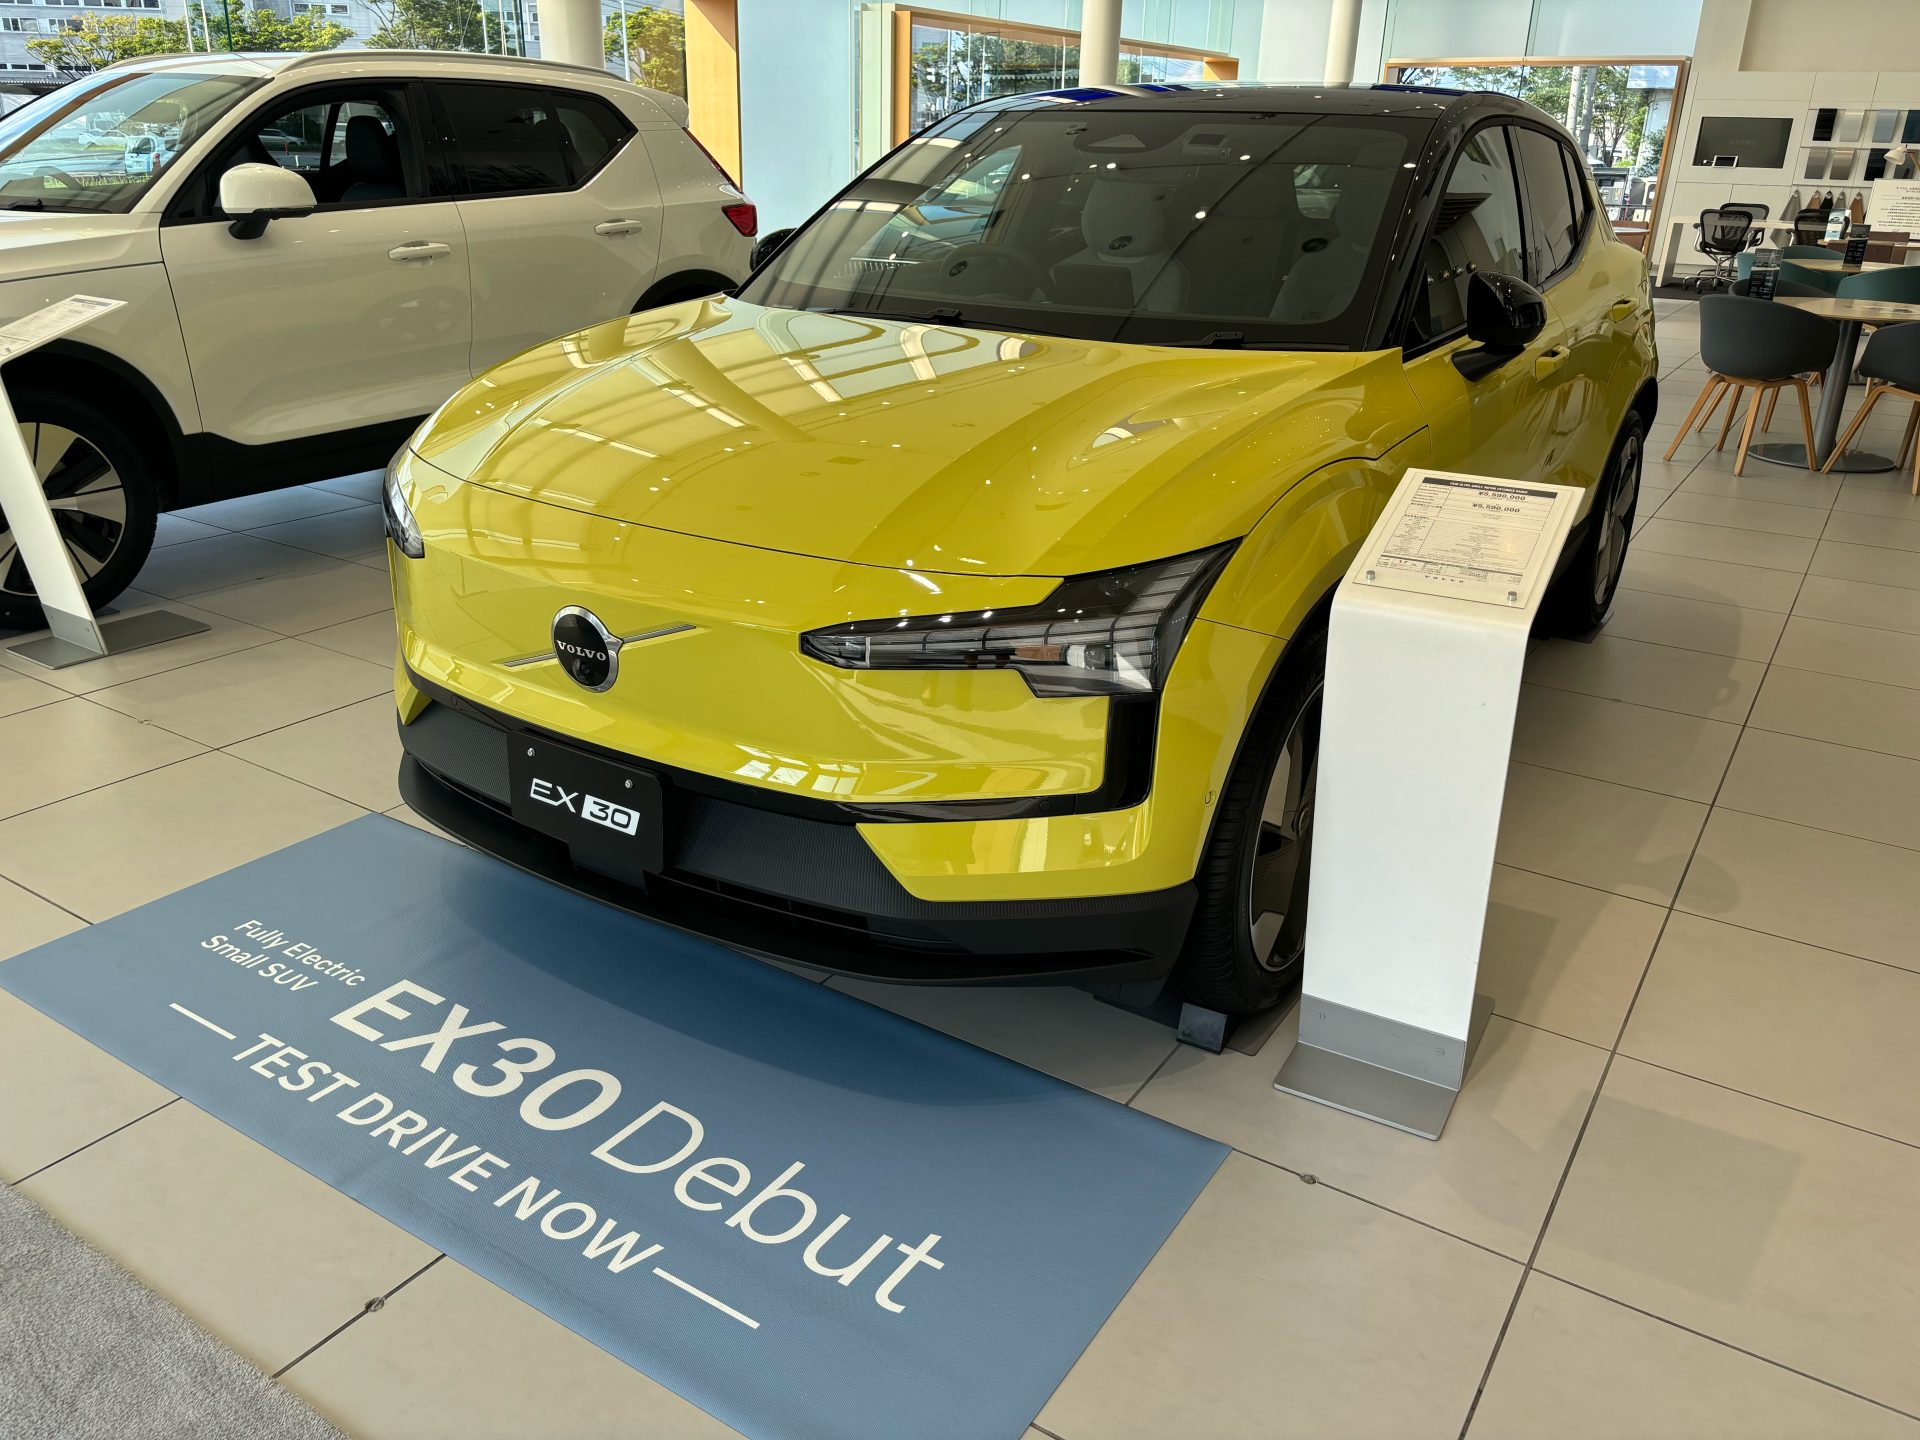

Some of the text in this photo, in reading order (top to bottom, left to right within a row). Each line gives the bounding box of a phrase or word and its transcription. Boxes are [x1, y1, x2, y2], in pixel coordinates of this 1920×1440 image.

[1472, 502, 1520, 513] ¥5,590,000
[556, 640, 607, 661] VOLVO
[200, 934, 320, 992] Small SUV
[233, 919, 366, 986] Fully Electric
[231, 1032, 665, 1274] TEST DRIVE NOW
[329, 978, 946, 1314] EX30 Debut
